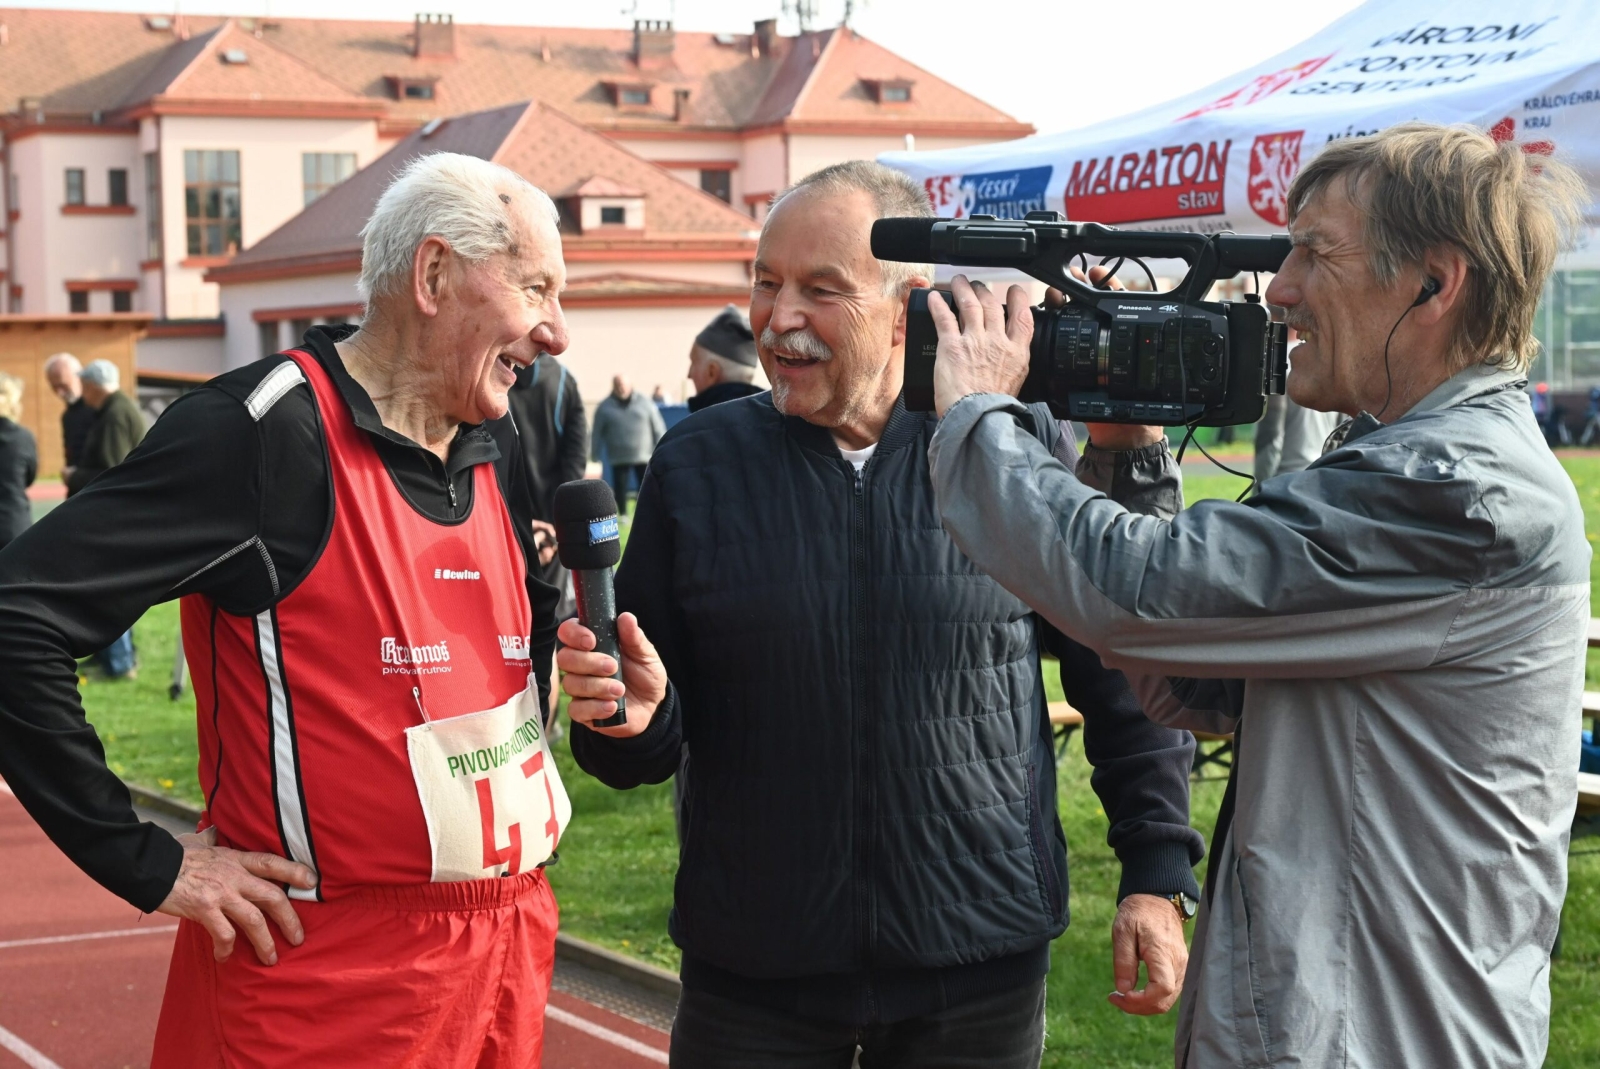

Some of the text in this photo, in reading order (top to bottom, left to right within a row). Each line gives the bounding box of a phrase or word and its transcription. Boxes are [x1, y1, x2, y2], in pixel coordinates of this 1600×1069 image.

[1523, 115, 1551, 129] KRAJ
[1067, 139, 1232, 199] MARATON
[1177, 191, 1220, 210] stav
[447, 741, 510, 778] PIVOVAR
